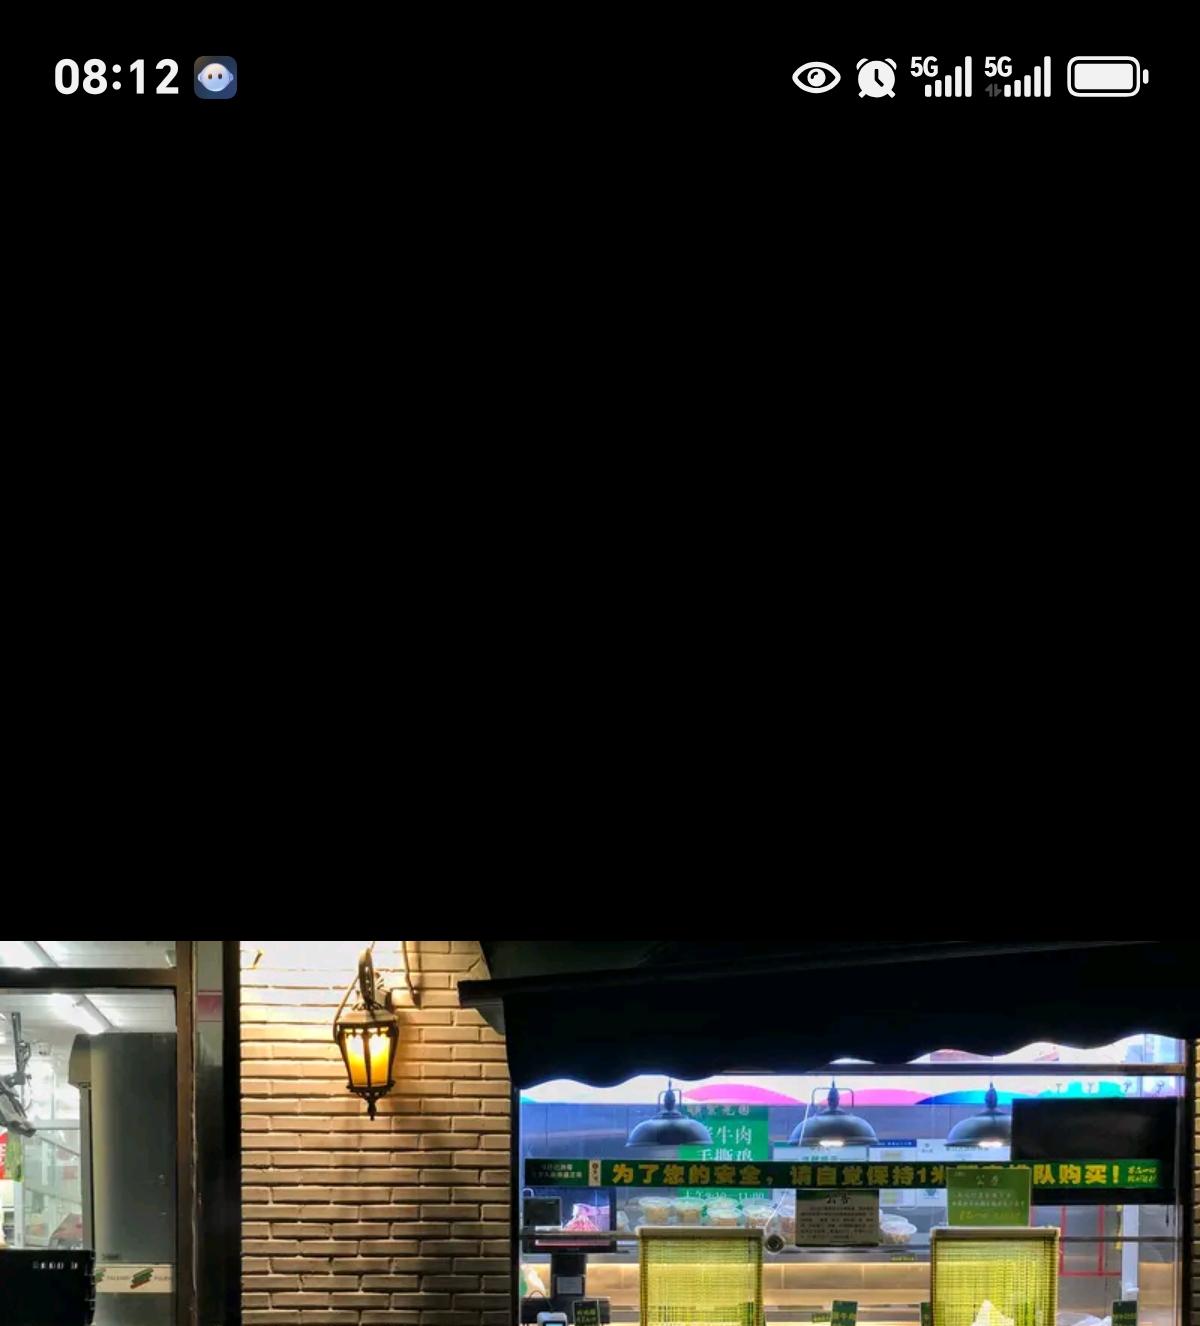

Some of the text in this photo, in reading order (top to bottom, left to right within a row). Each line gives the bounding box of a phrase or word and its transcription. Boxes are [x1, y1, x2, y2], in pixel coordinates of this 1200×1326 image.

[611, 1162, 1120, 1186] 为了您的安全，请自觉保持1米队购买！
